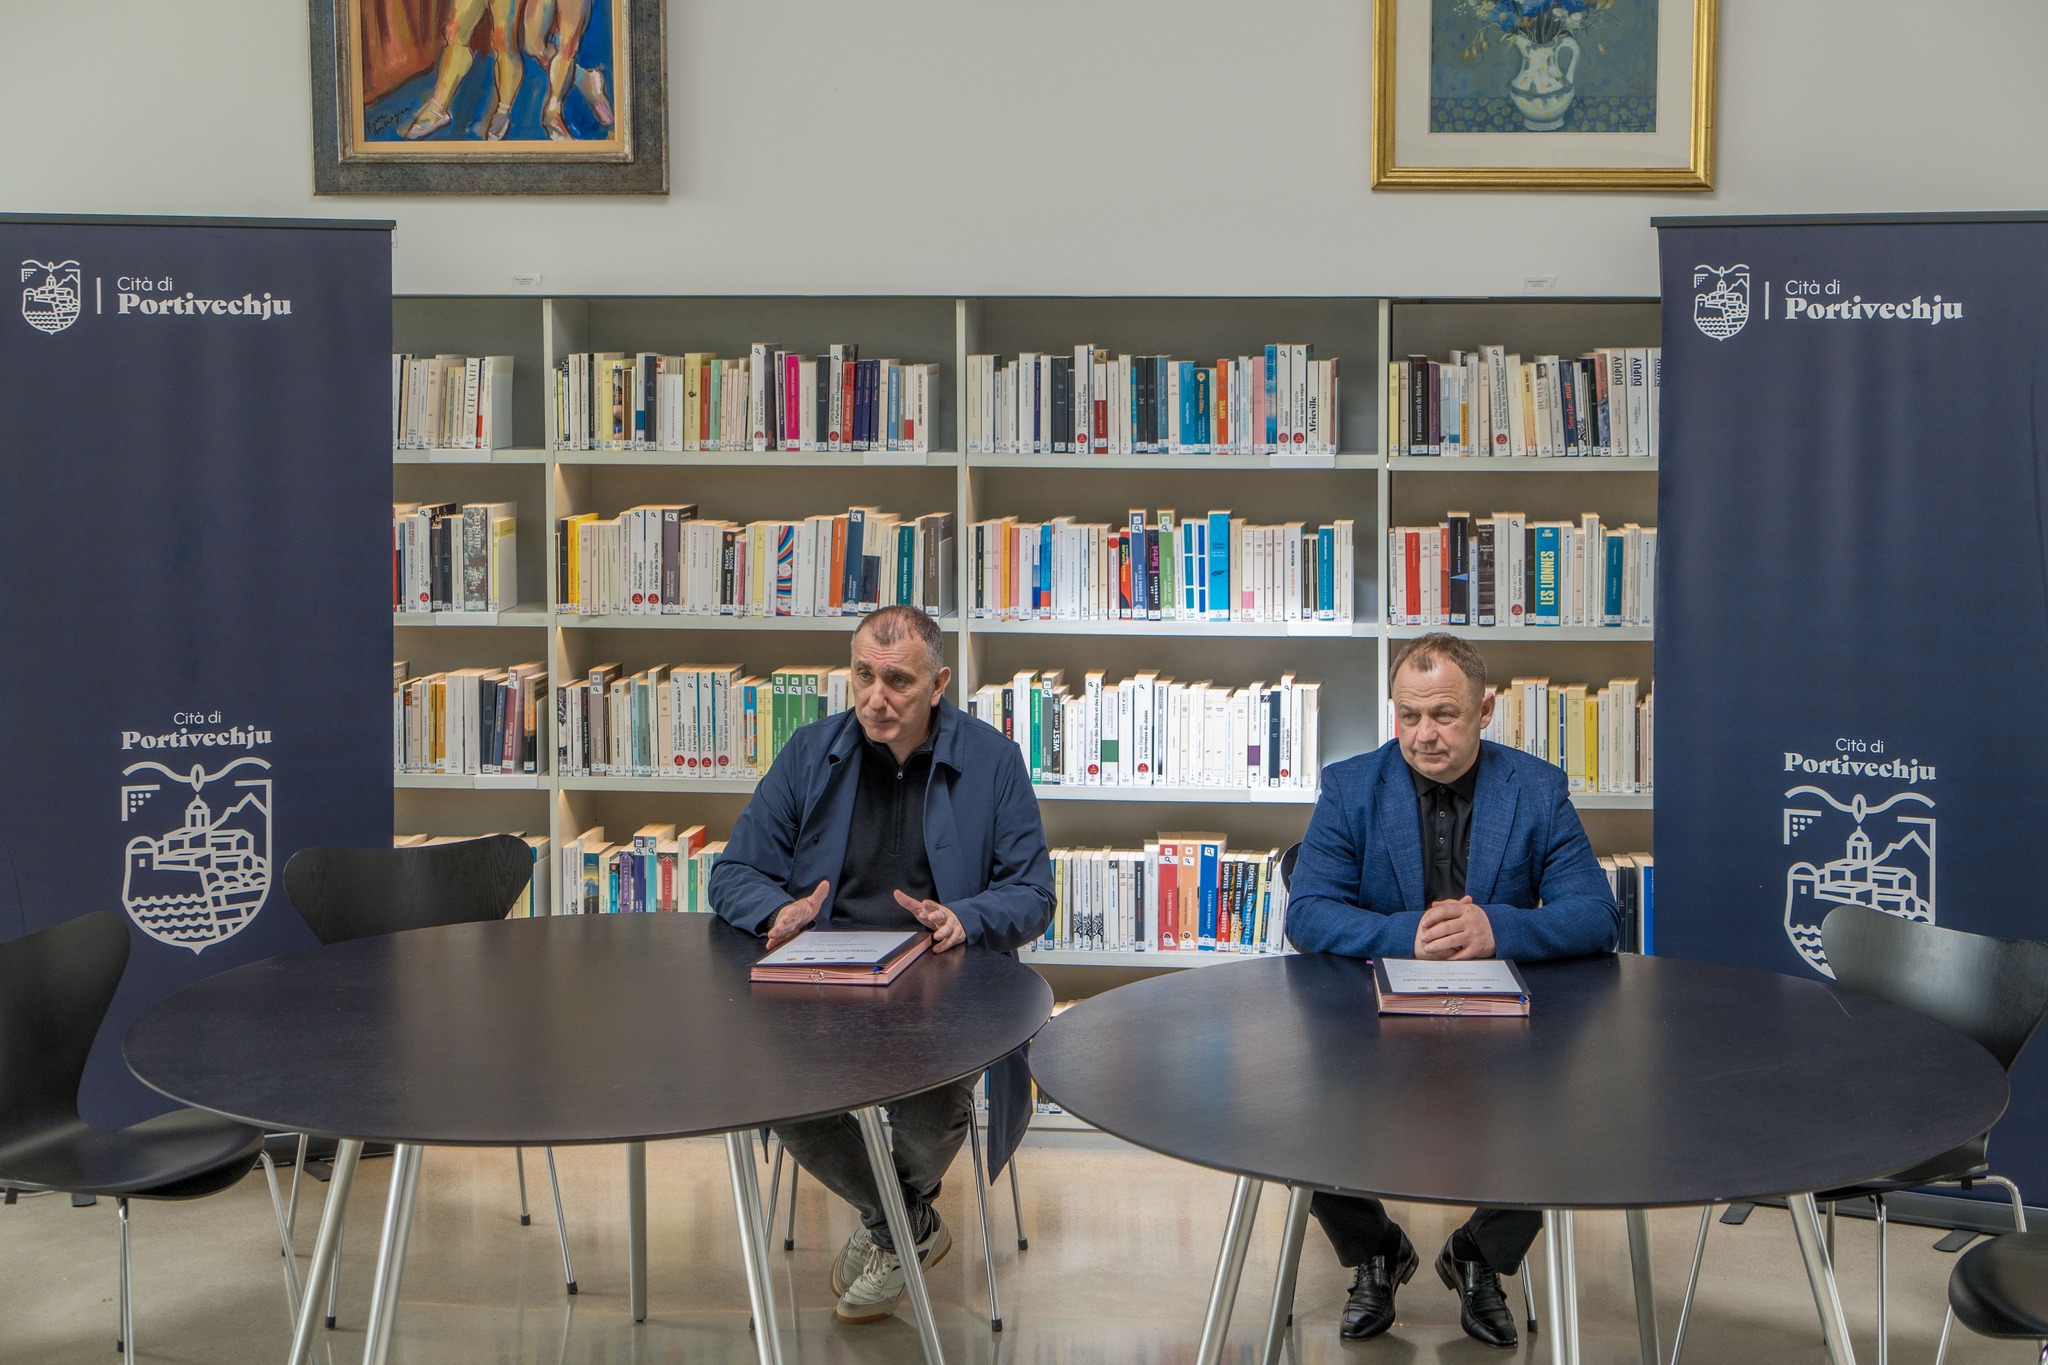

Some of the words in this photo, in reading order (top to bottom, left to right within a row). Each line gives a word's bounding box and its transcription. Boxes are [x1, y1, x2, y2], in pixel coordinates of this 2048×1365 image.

[117, 276, 153, 291] Cità
[157, 276, 173, 291] di
[1785, 279, 1820, 295] Cità
[1825, 278, 1840, 295] di
[117, 292, 292, 321] Portivechju
[1785, 295, 1963, 325] Portivechju
[1614, 356, 1623, 385] DUPUY
[1633, 357, 1642, 386] DUPUY
[1567, 405, 1575, 429] Sortir
[1541, 551, 1554, 588] LIONNES
[1540, 590, 1554, 605] LES
[173, 711, 204, 725] Cità
[208, 710, 222, 724] di
[121, 725, 272, 750] Portivechju
[1835, 738, 1866, 753] Cità
[1870, 739, 1884, 754] di
[1784, 752, 1936, 784] Portivechju
